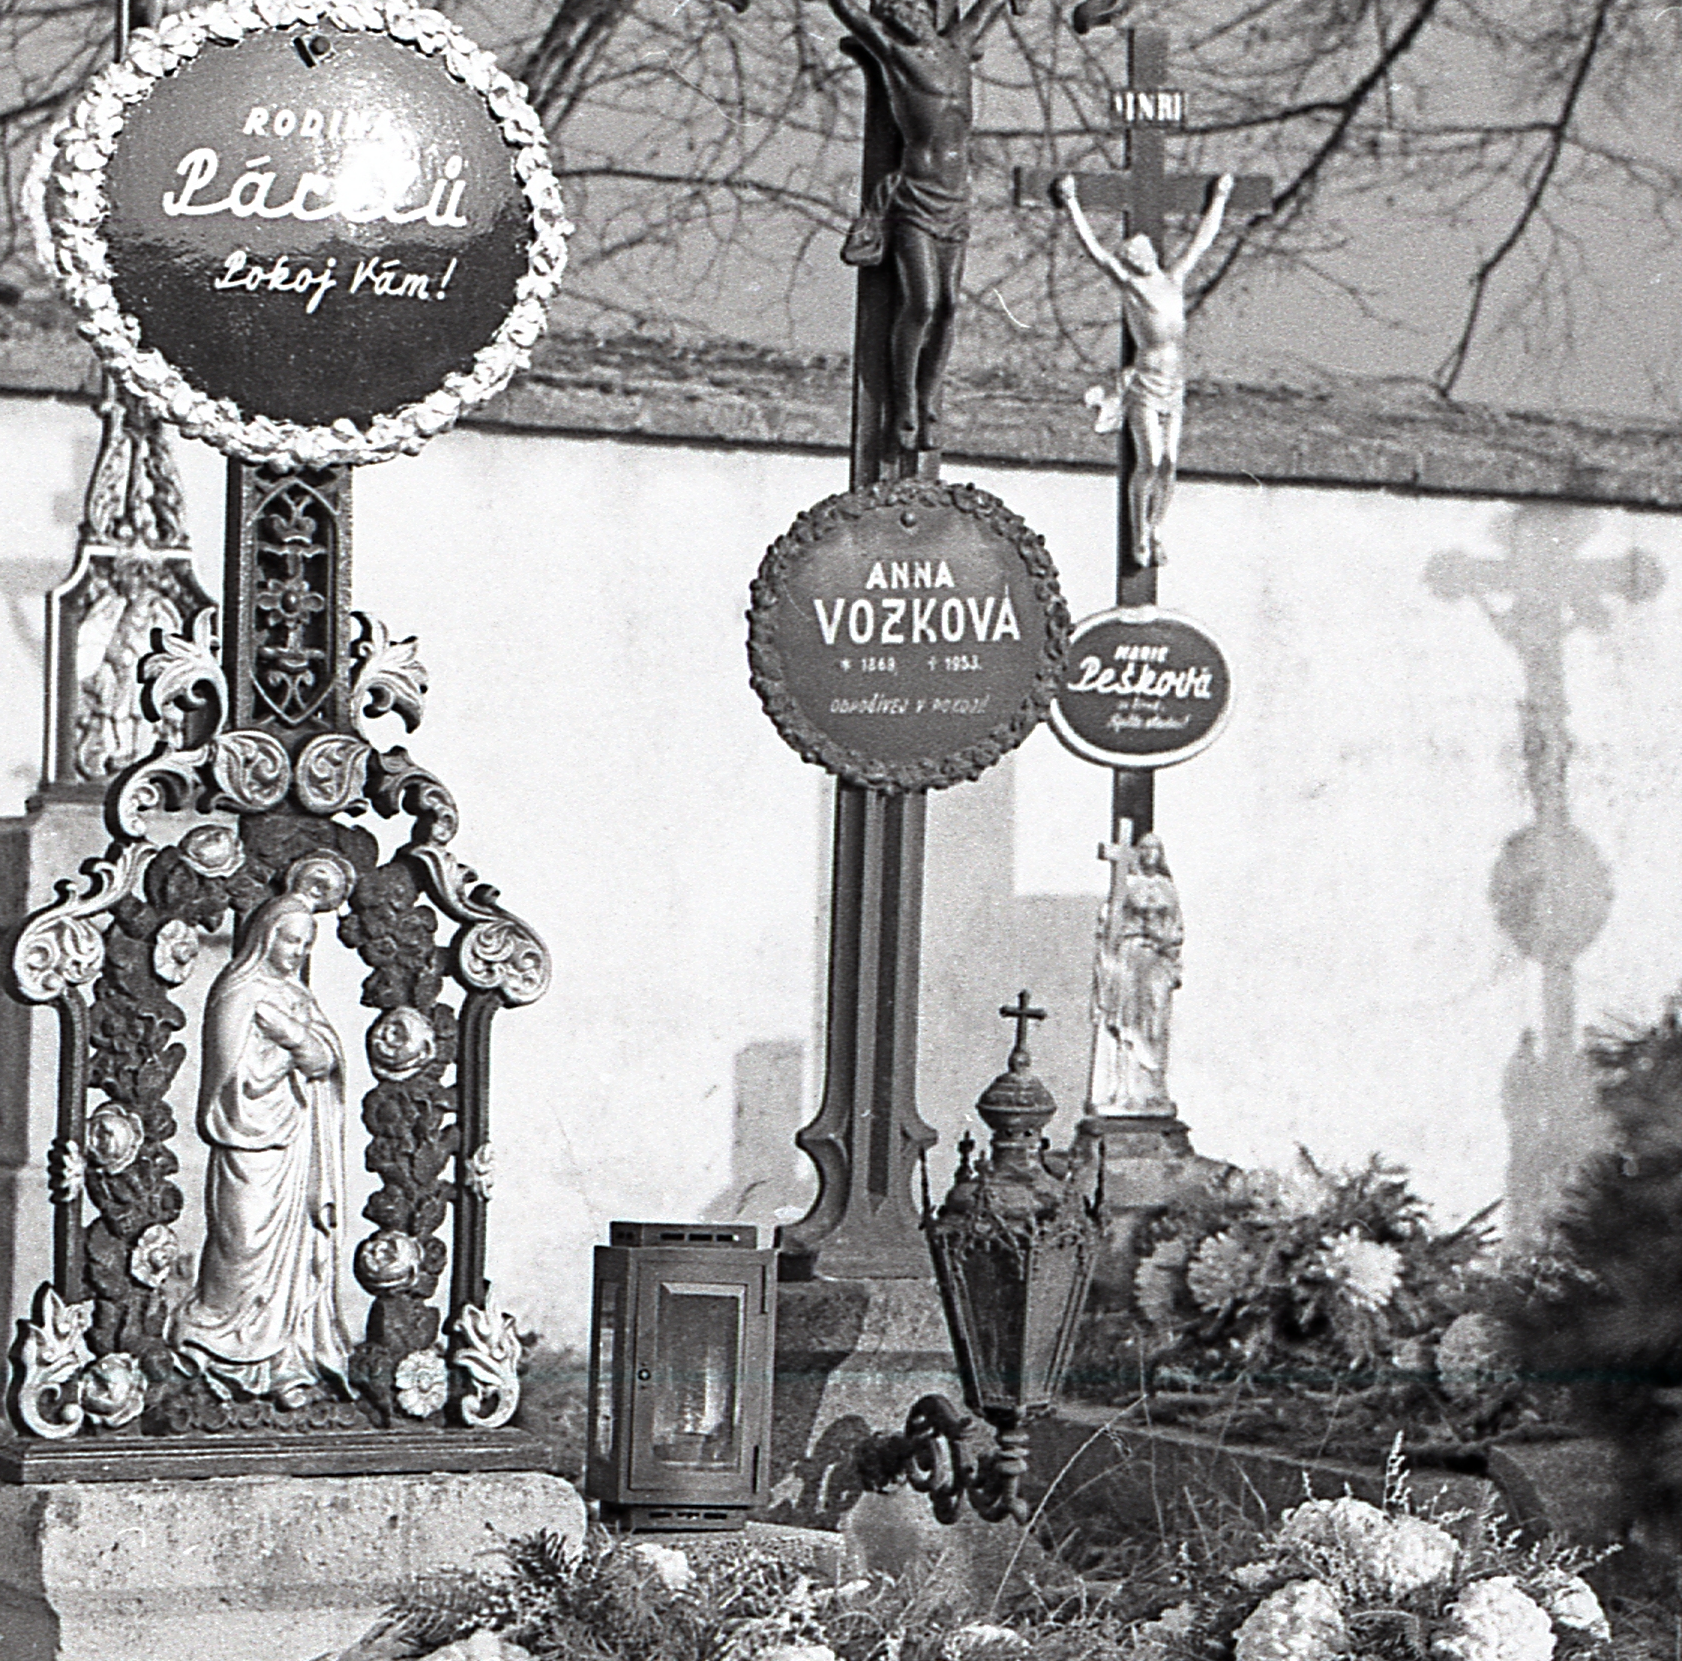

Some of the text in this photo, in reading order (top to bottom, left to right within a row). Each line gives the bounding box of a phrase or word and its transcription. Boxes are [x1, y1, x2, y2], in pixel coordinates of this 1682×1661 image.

[242, 105, 395, 139] RODINA
[1125, 91, 1181, 122] INRI
[215, 249, 338, 314] Pokoj
[865, 561, 956, 590] ANNA
[1067, 655, 1213, 700] Pešková
